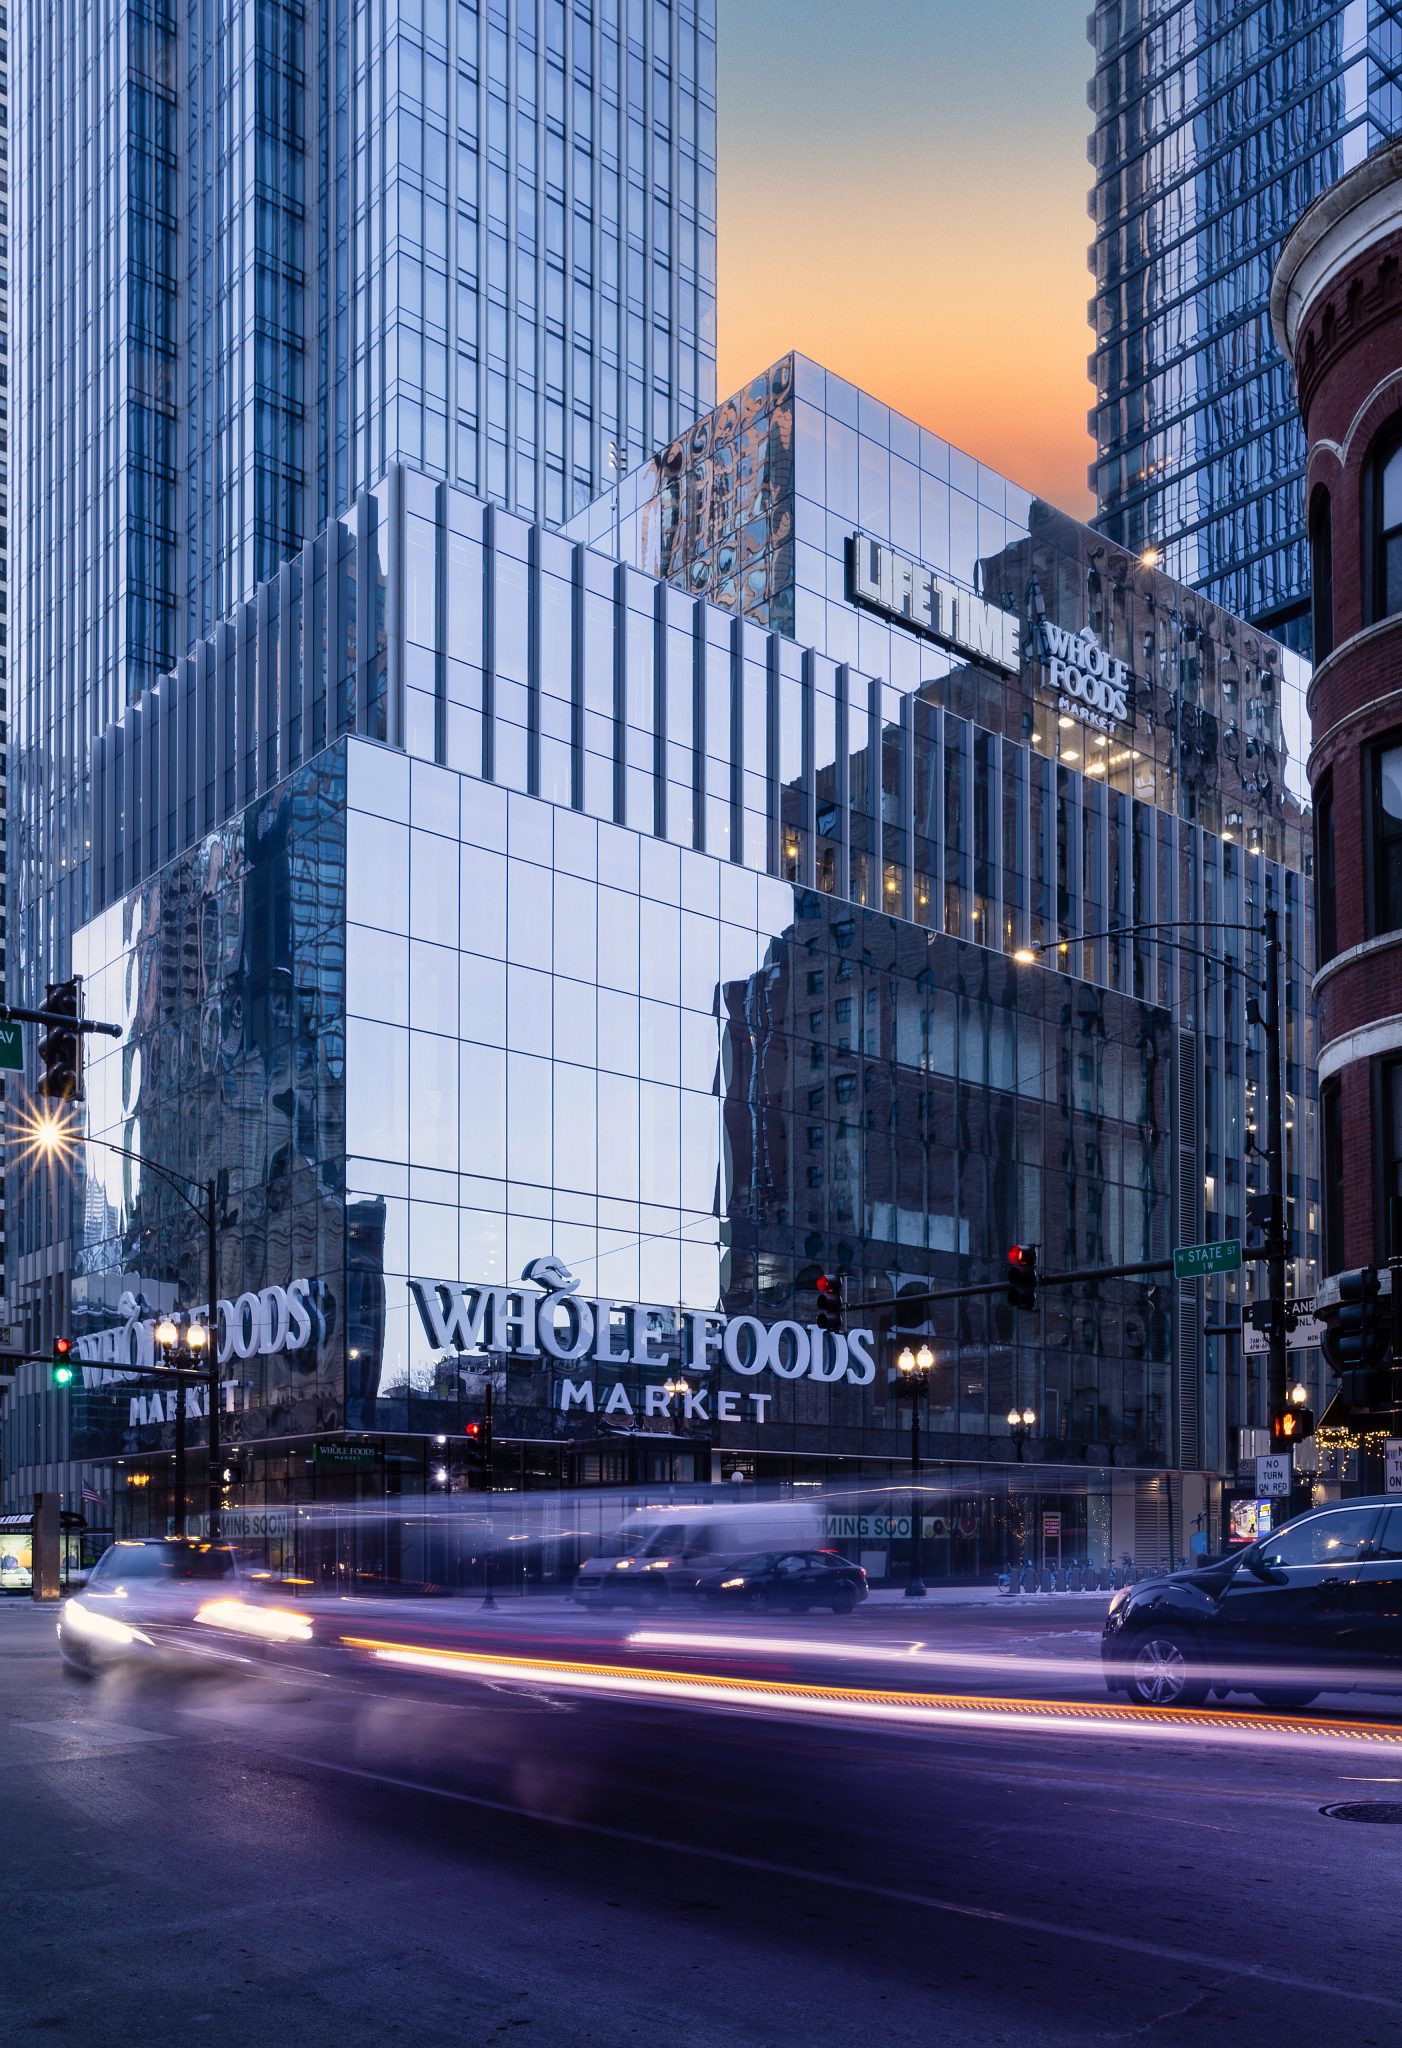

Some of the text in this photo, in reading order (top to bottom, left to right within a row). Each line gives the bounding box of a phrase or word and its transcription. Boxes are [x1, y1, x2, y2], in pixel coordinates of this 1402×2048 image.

[1043, 621, 1130, 691] WHOLE
[1049, 656, 1128, 720] FOODS
[1058, 697, 1116, 733] MARKET
[1178, 1245, 1236, 1263] N STATE ST
[1288, 1301, 1315, 1314] ANE
[1299, 1317, 1317, 1327] NLY
[407, 1278, 876, 1386] WHOLE FOODS
[560, 1379, 773, 1424] MARKET
[320, 1445, 375, 1455] WHOLE FOODS
[1266, 1460, 1279, 1468] NO
[1263, 1471, 1283, 1480] TURN
[1259, 1483, 1268, 1491] ON
[205, 1514, 250, 1536] CMING
[253, 1513, 286, 1535] SOON
[820, 1516, 913, 1536] MING SOO
